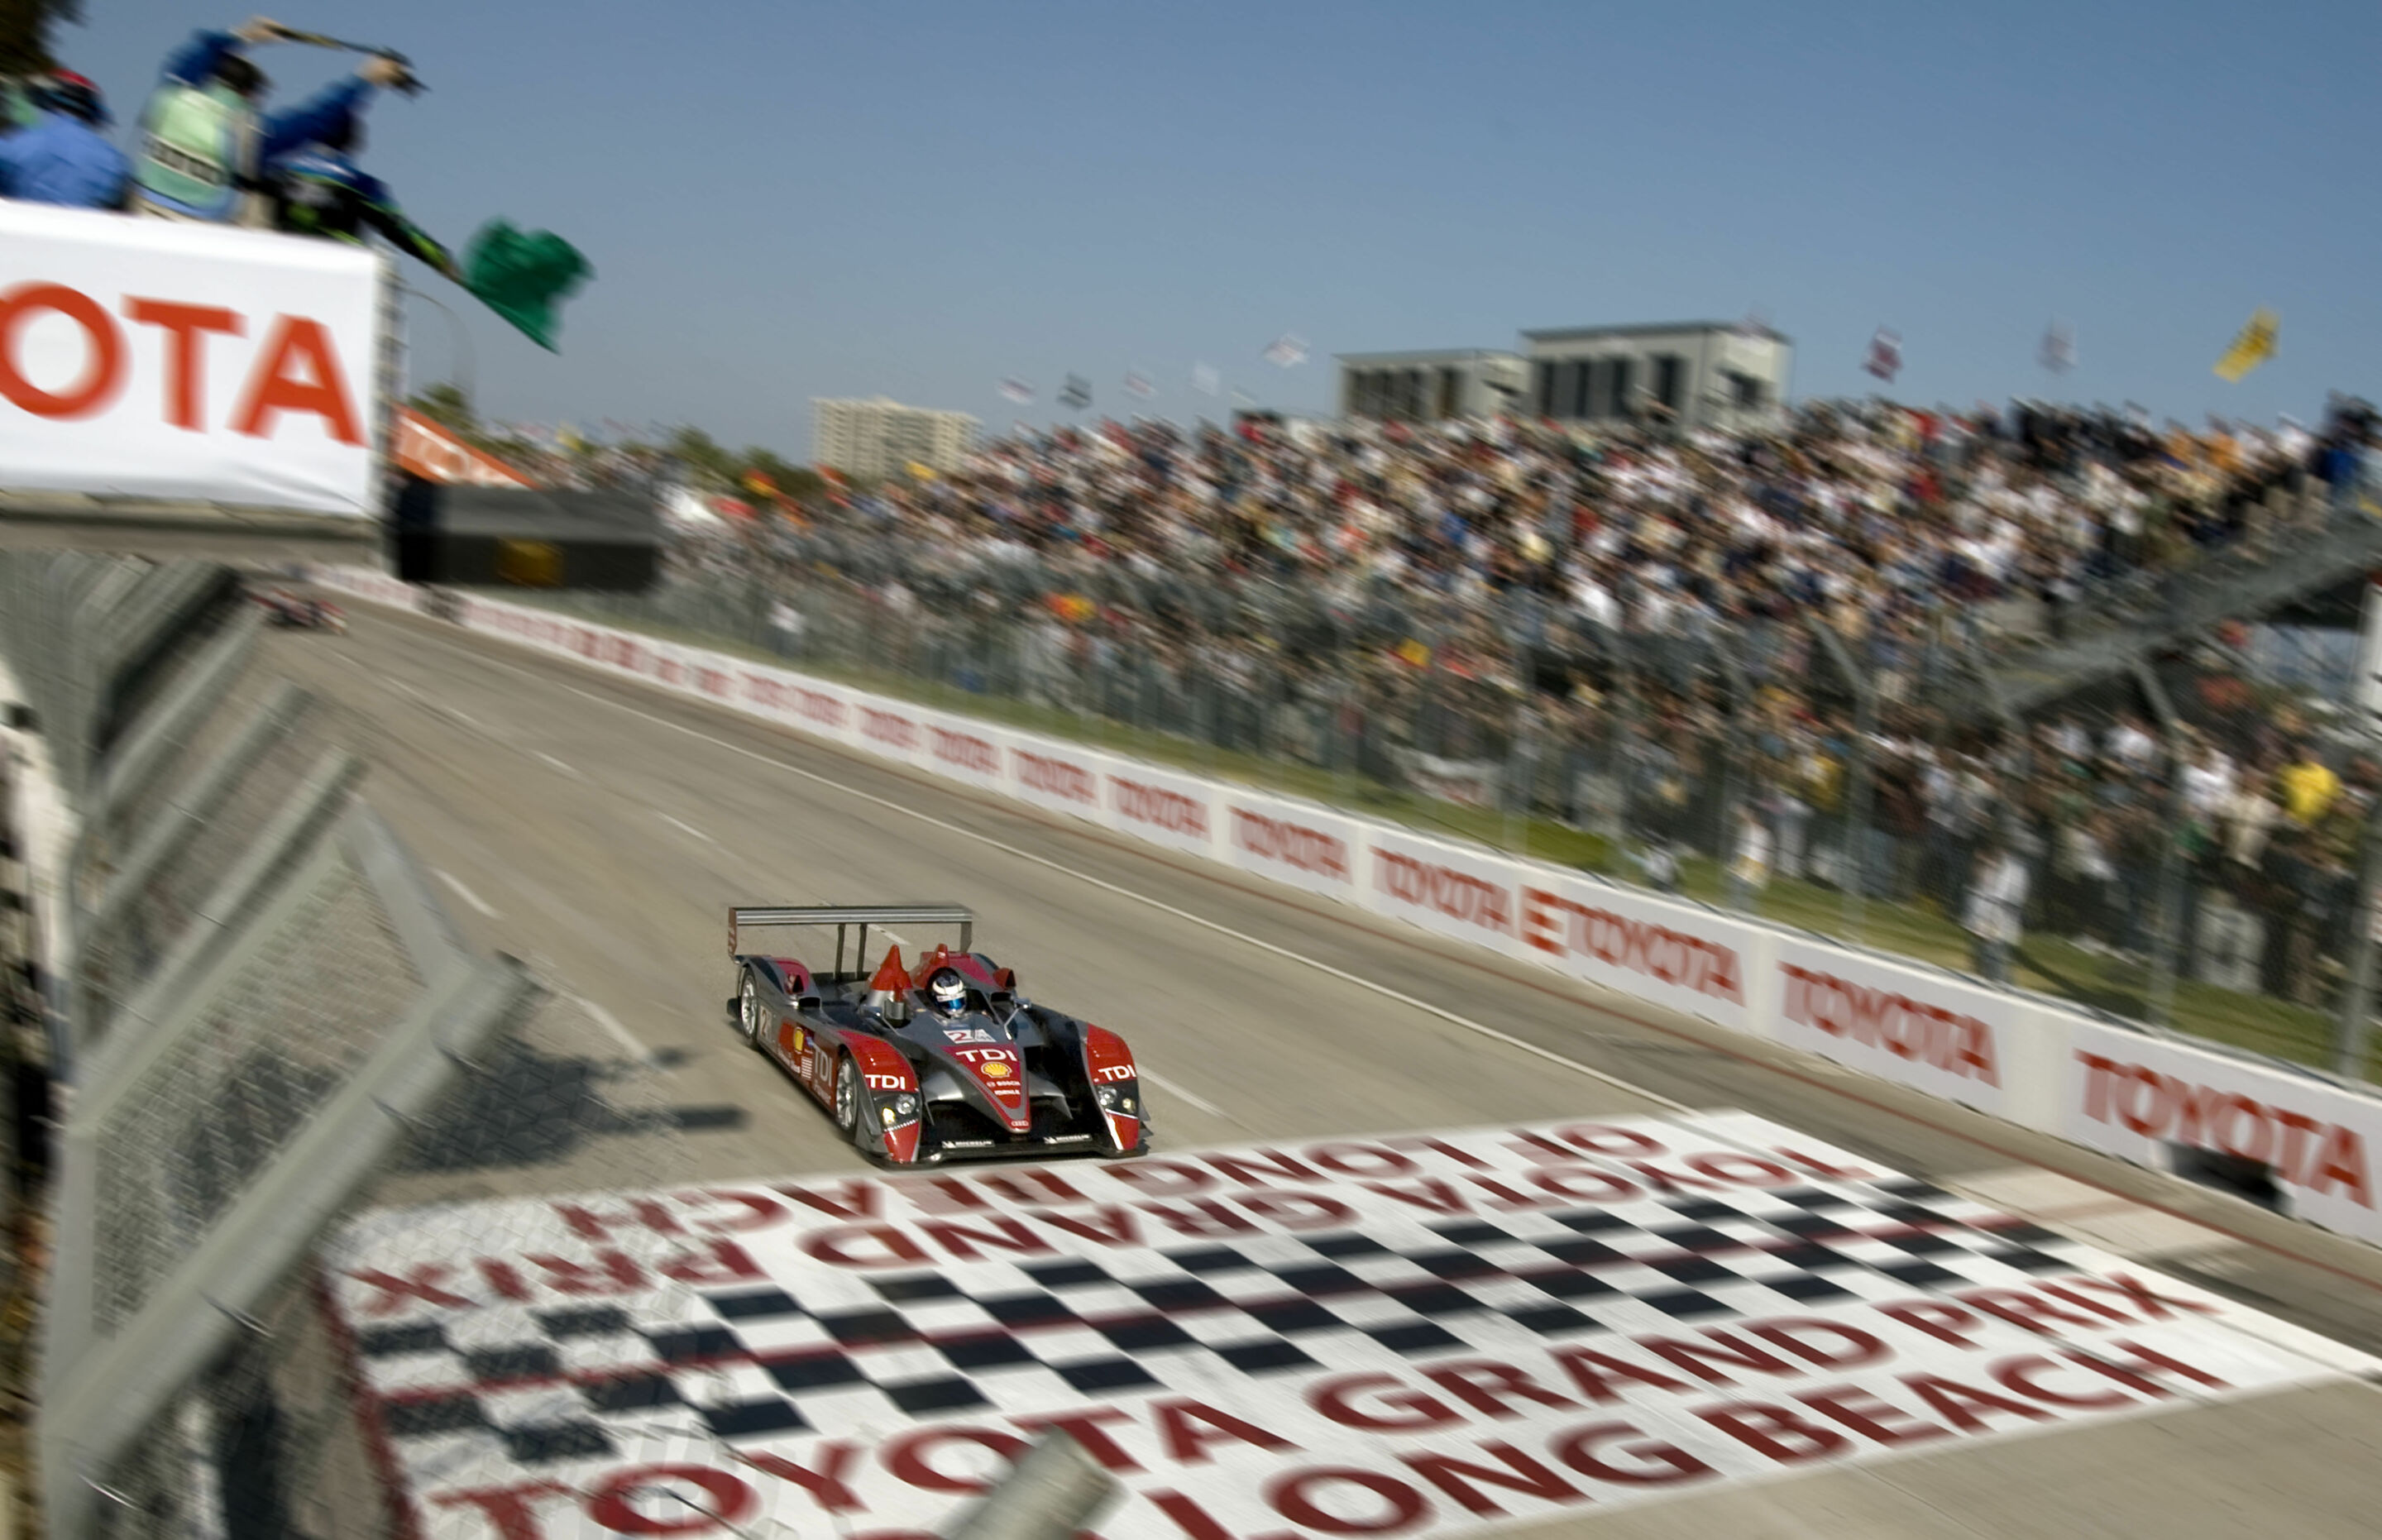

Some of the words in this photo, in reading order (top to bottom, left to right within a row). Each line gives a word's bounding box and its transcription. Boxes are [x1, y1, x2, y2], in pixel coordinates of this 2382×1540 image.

[1371, 844, 1517, 935] TOYOTA
[1562, 896, 1748, 1008] TOYOTA
[949, 1031, 974, 1041] 2
[955, 1049, 1018, 1062] TDI
[1777, 960, 2004, 1091] TOYOTA
[864, 1074, 906, 1090] TDI
[1098, 1064, 1137, 1081] TDI
[2073, 1048, 2377, 1212] TOYOTA
[794, 1192, 1365, 1270] GRAND
[426, 1398, 1311, 1540] TOYOTA
[1301, 1315, 1896, 1452] GRAND
[1867, 1271, 2225, 1352] PRIX
[1683, 1338, 2241, 1468] BEACH
